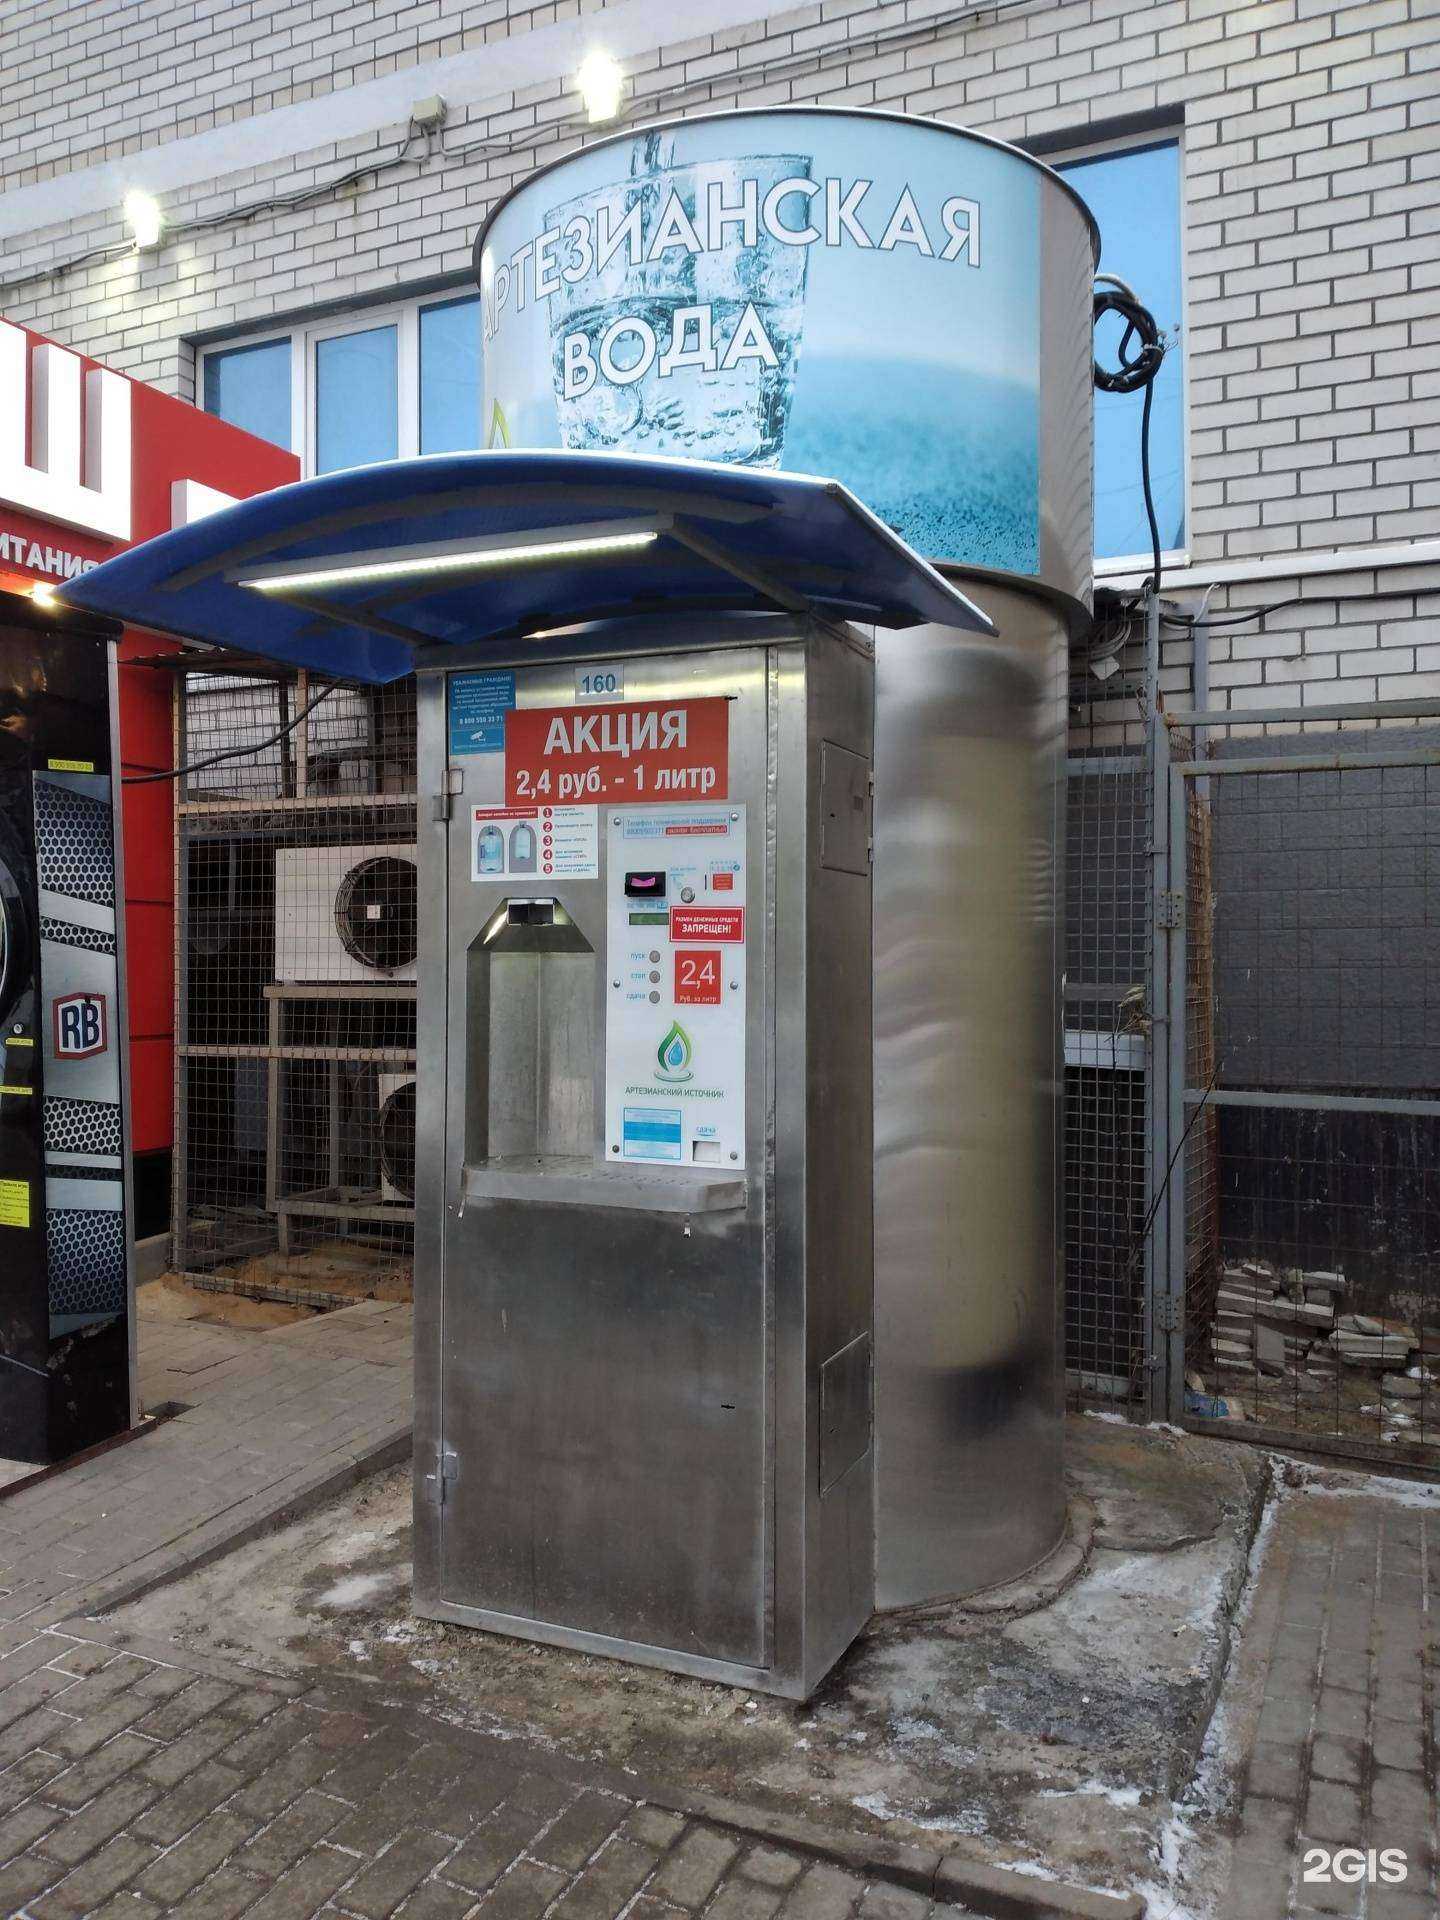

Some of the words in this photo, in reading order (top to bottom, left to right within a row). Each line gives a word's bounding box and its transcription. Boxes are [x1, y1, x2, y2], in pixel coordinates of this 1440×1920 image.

[562, 301, 780, 401] ВОДА
[581, 673, 616, 695] 160
[543, 709, 688, 758] АКЦИЯ
[516, 768, 552, 800] 2,4
[558, 765, 607, 799] руб.
[633, 764, 644, 790] 1
[655, 765, 716, 795] литр
[682, 923, 732, 935] ЗАПРЕЩЕН!
[680, 959, 716, 990] 2,4
[61, 1003, 100, 1050] RB
[624, 1086, 683, 1097] АРТЕЗИАНСКИЙ
